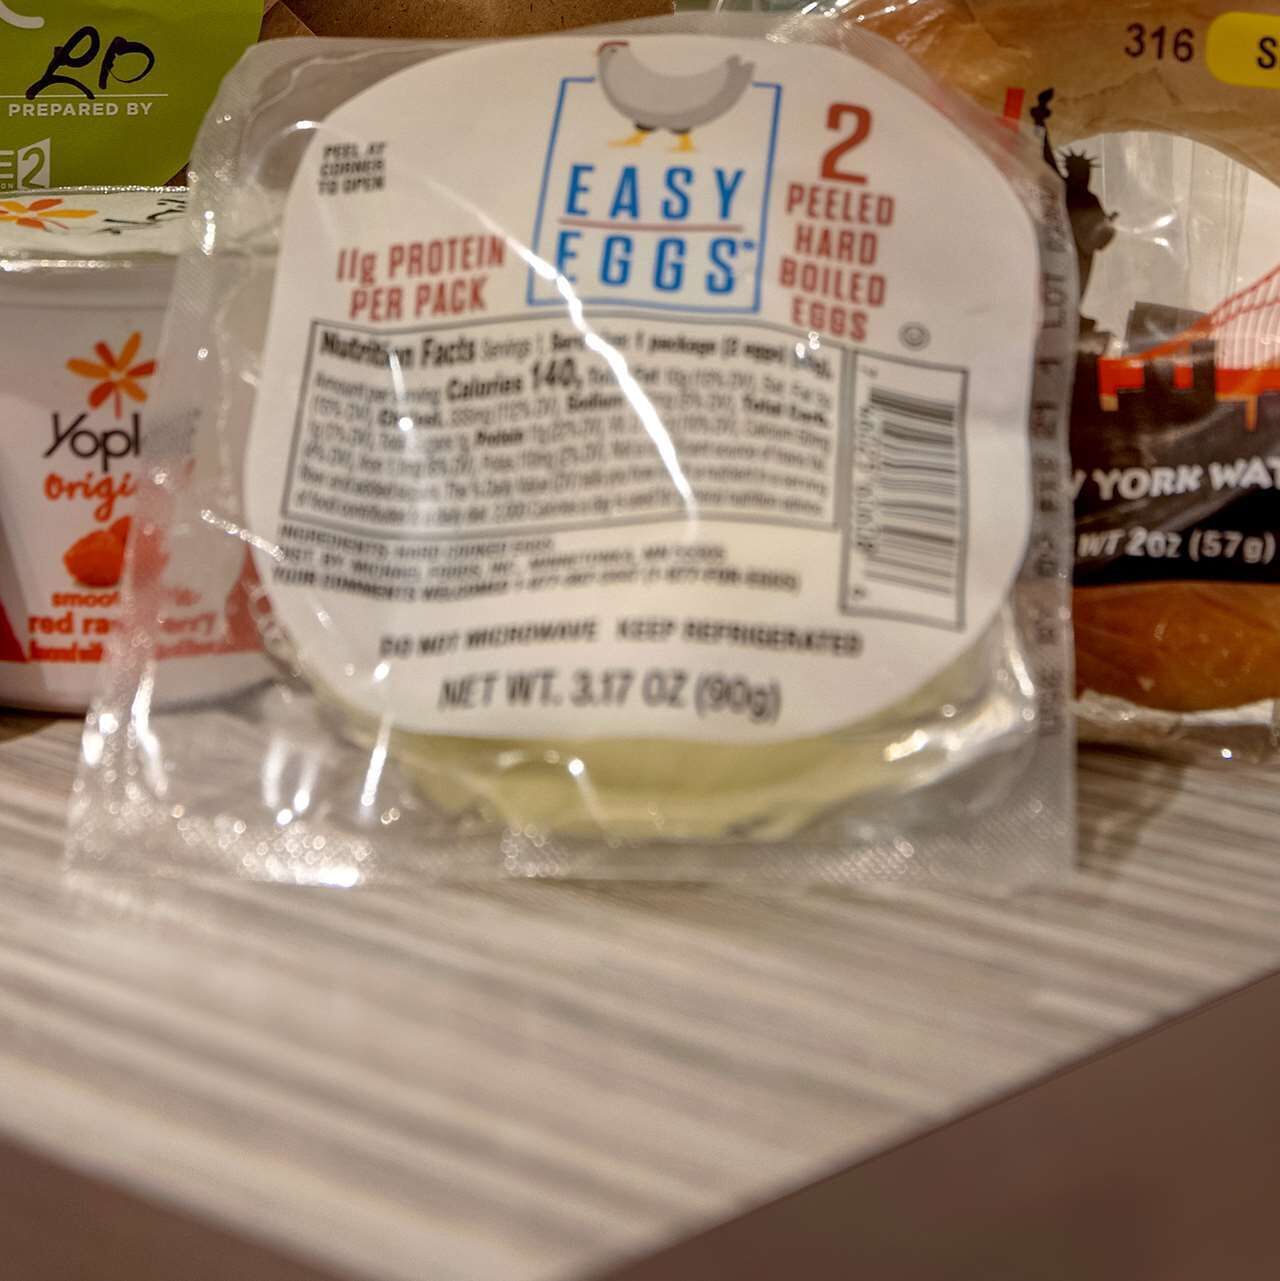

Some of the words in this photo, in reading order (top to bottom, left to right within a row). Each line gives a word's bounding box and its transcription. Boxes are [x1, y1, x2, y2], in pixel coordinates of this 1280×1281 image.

[1124, 23, 1195, 63] 316
[8, 103, 119, 117] PREPARED
[125, 103, 153, 116] BY
[324, 143, 359, 159] PEEL
[820, 102, 873, 185] 2
[318, 180, 338, 195] TO
[342, 176, 385, 195] OPEN
[320, 159, 384, 177] CORNER
[565, 163, 745, 220] EASY
[786, 181, 896, 226] PEELED
[388, 233, 507, 279] PROTEIN
[556, 230, 740, 295] EGGS
[795, 223, 878, 266] HARD
[349, 286, 403, 322] PER
[414, 275, 488, 318] PACK
[779, 256, 887, 308] BOILED
[792, 296, 868, 342] EGGS
[421, 335, 476, 369] Facts
[445, 374, 524, 402] Calories
[43, 470, 141, 523] Origi
[1093, 464, 1204, 501] YORK
[1124, 525, 1182, 559] 2oz
[1188, 528, 1276, 566] (57g)
[28, 612, 74, 634] red
[417, 629, 461, 656] NOT
[465, 617, 597, 650] MICROWAVE
[616, 618, 675, 643] KEEP
[682, 619, 864, 658] REFRIGERATED
[439, 671, 499, 708] NET
[506, 667, 562, 707] WT.
[570, 669, 636, 708] 3.17
[641, 669, 688, 709] OZ
[693, 672, 782, 726] (90g)
